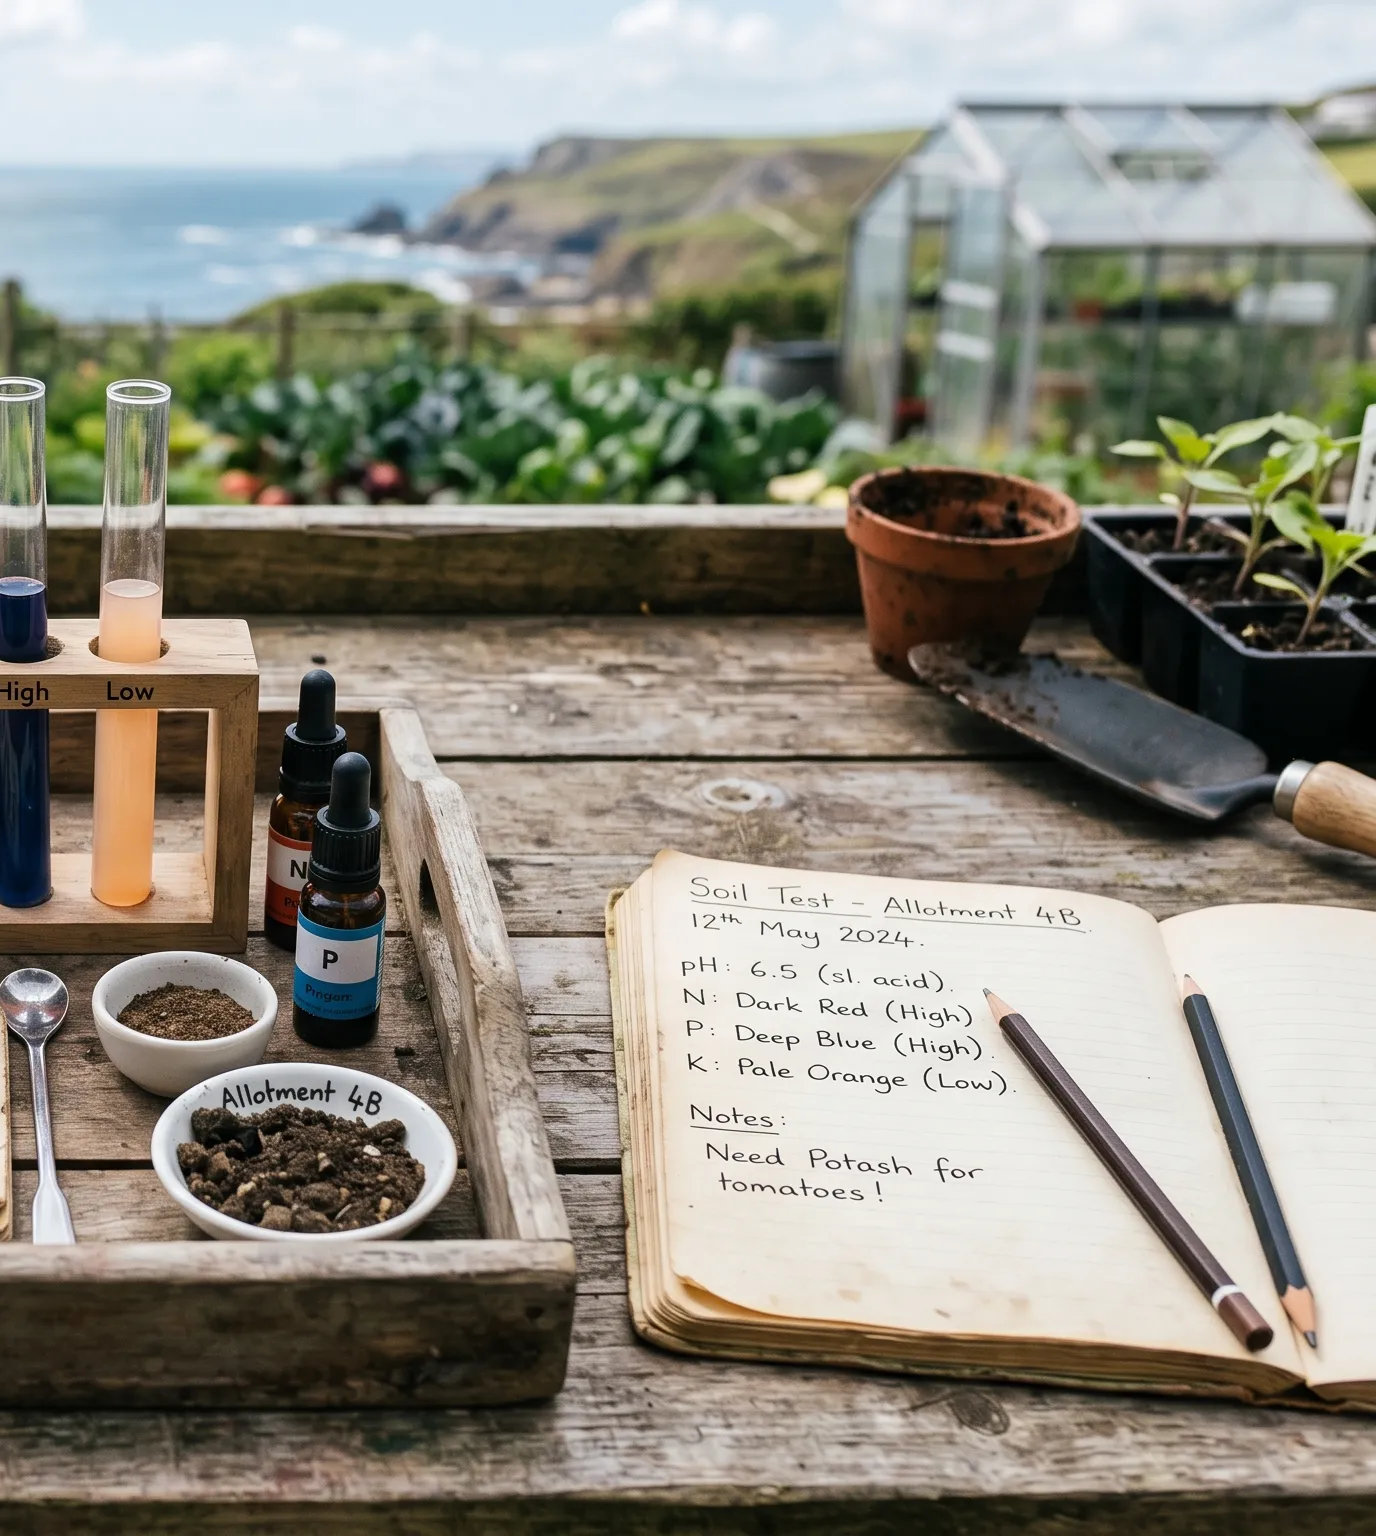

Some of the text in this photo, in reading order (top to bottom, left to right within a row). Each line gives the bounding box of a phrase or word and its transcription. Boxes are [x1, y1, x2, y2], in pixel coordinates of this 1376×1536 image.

[107, 680, 155, 701] Low
[290, 859, 308, 880] N
[690, 877, 748, 902] Soil
[767, 885, 835, 909] Test
[883, 895, 1017, 920] Allotment
[691, 912, 924, 949] 12th May 2024.
[322, 948, 339, 970] P
[680, 955, 955, 994] pH: 6.5 (sl. acid).
[683, 988, 973, 1029] N: Dark Red (High)
[686, 1019, 996, 1063] P: Deep Blue (High).
[687, 1053, 1017, 1096] K: Pale Orange (Low).
[222, 1079, 384, 1117] Allotment 4B
[690, 1103, 786, 1128] Notes:
[706, 1142, 983, 1183] Need Potash for
[719, 1170, 888, 1203] tomatoes!
